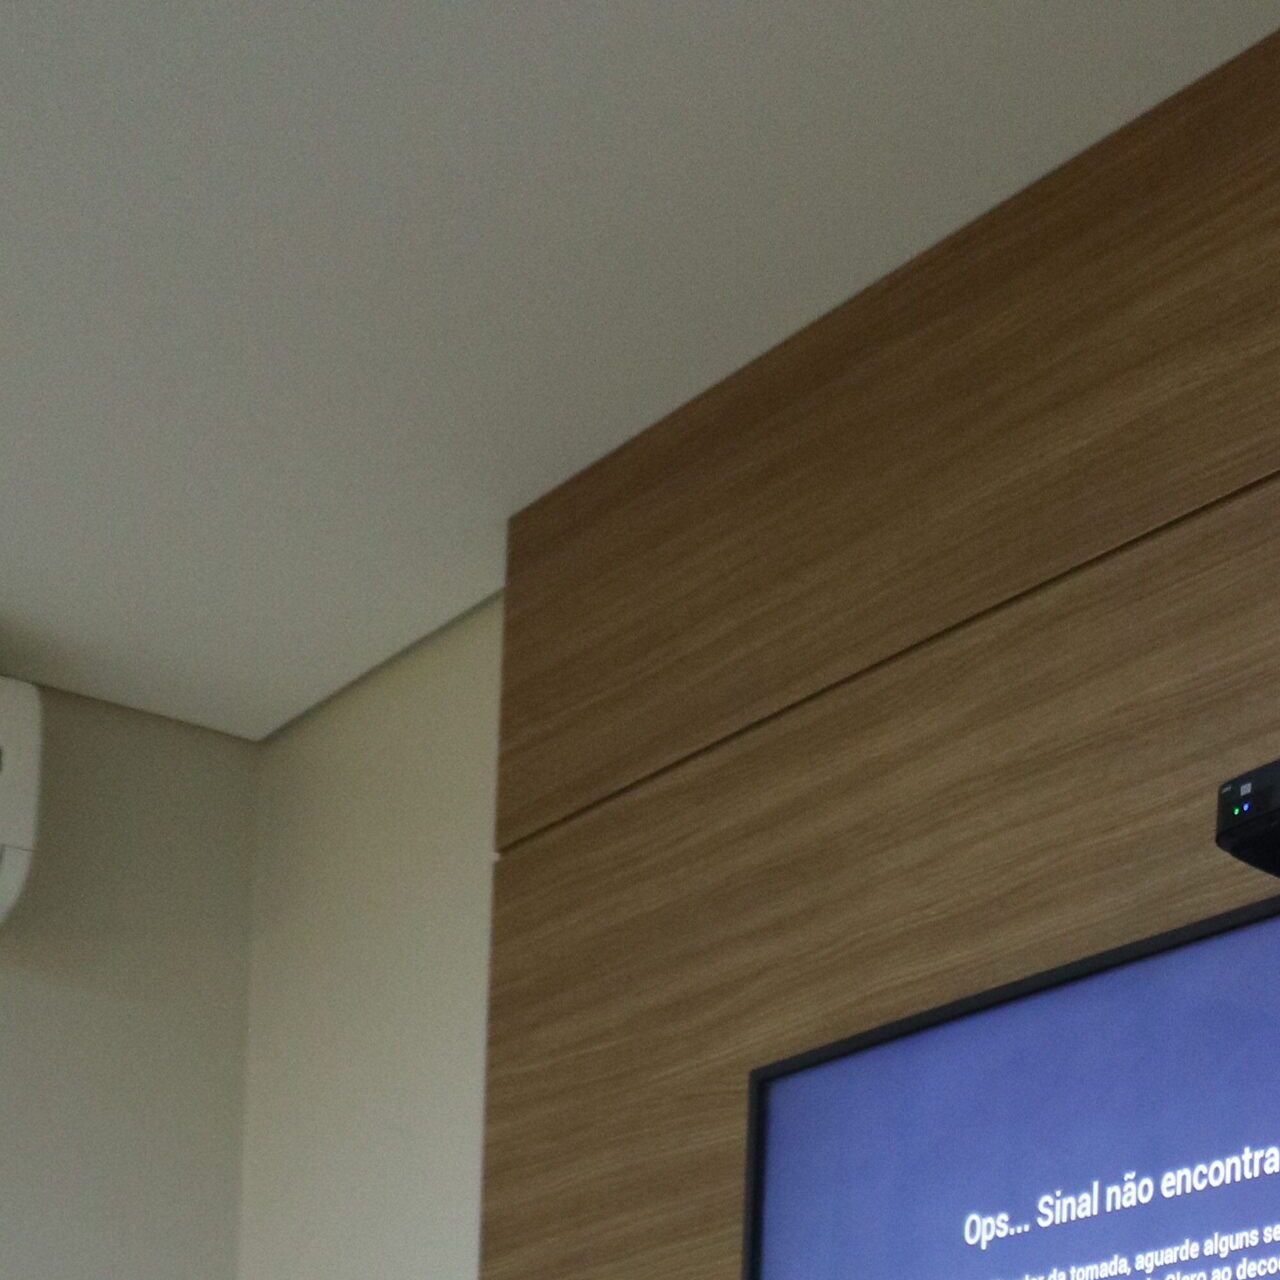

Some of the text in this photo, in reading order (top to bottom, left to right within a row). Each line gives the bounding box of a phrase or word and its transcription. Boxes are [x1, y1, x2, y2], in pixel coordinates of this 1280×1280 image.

[963, 1211, 1029, 1250] Ops...
[1036, 1180, 1099, 1227] Sinal
[1105, 1170, 1154, 1212] não
[1134, 1238, 1199, 1273] aguarde
[1203, 1228, 1259, 1257] alguns
